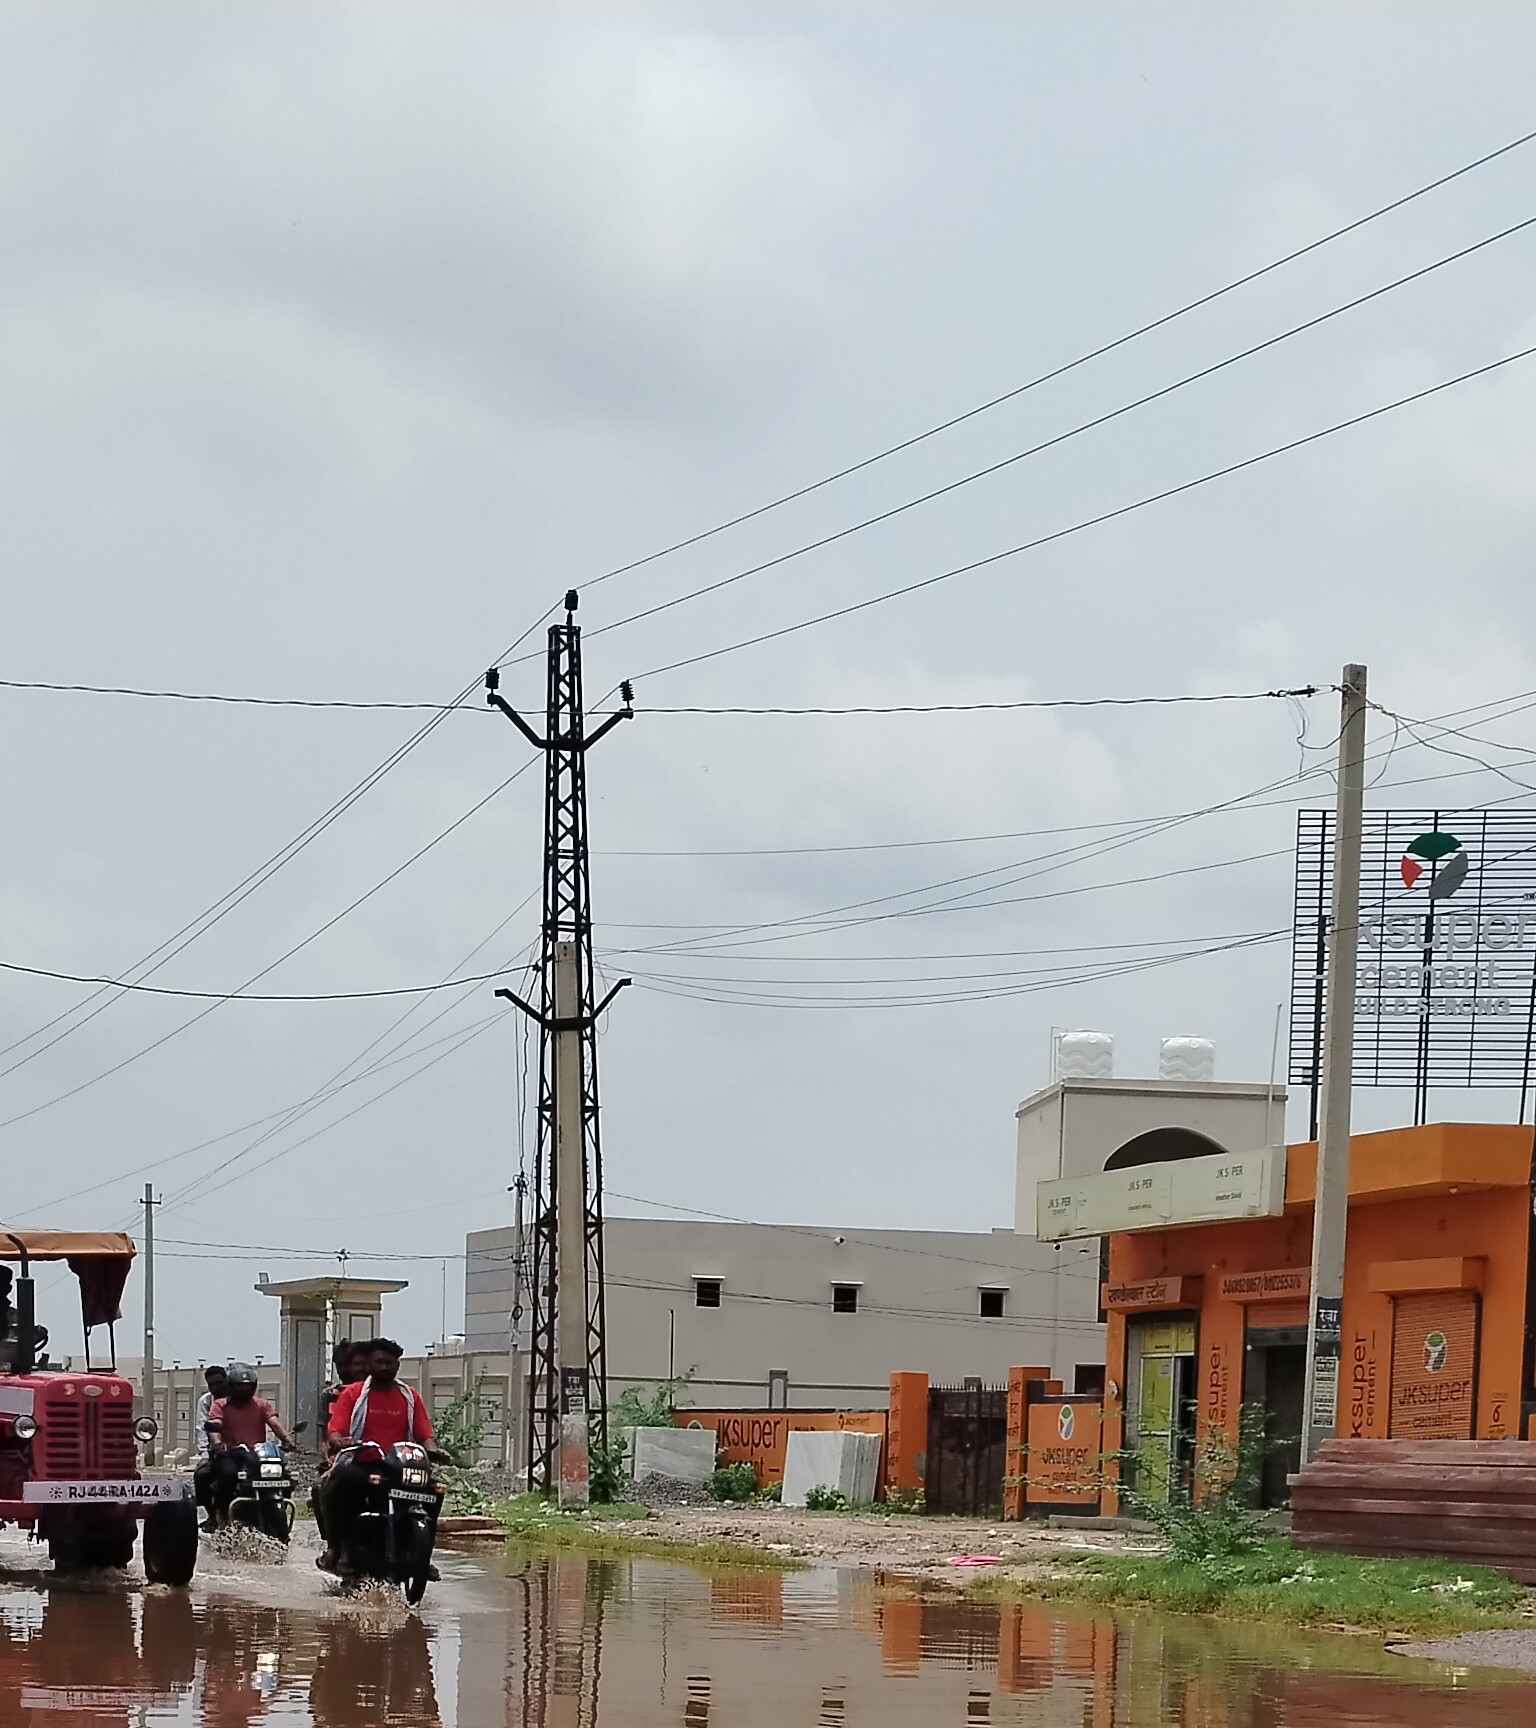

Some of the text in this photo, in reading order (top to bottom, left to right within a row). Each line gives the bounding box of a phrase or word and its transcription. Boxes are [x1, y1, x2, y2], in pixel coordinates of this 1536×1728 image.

[1360, 959, 1500, 989] cement
[1357, 996, 1511, 1016] UILD STRONG
[1350, 1332, 1369, 1438] Ksuper
[1366, 1358, 1377, 1427] cement
